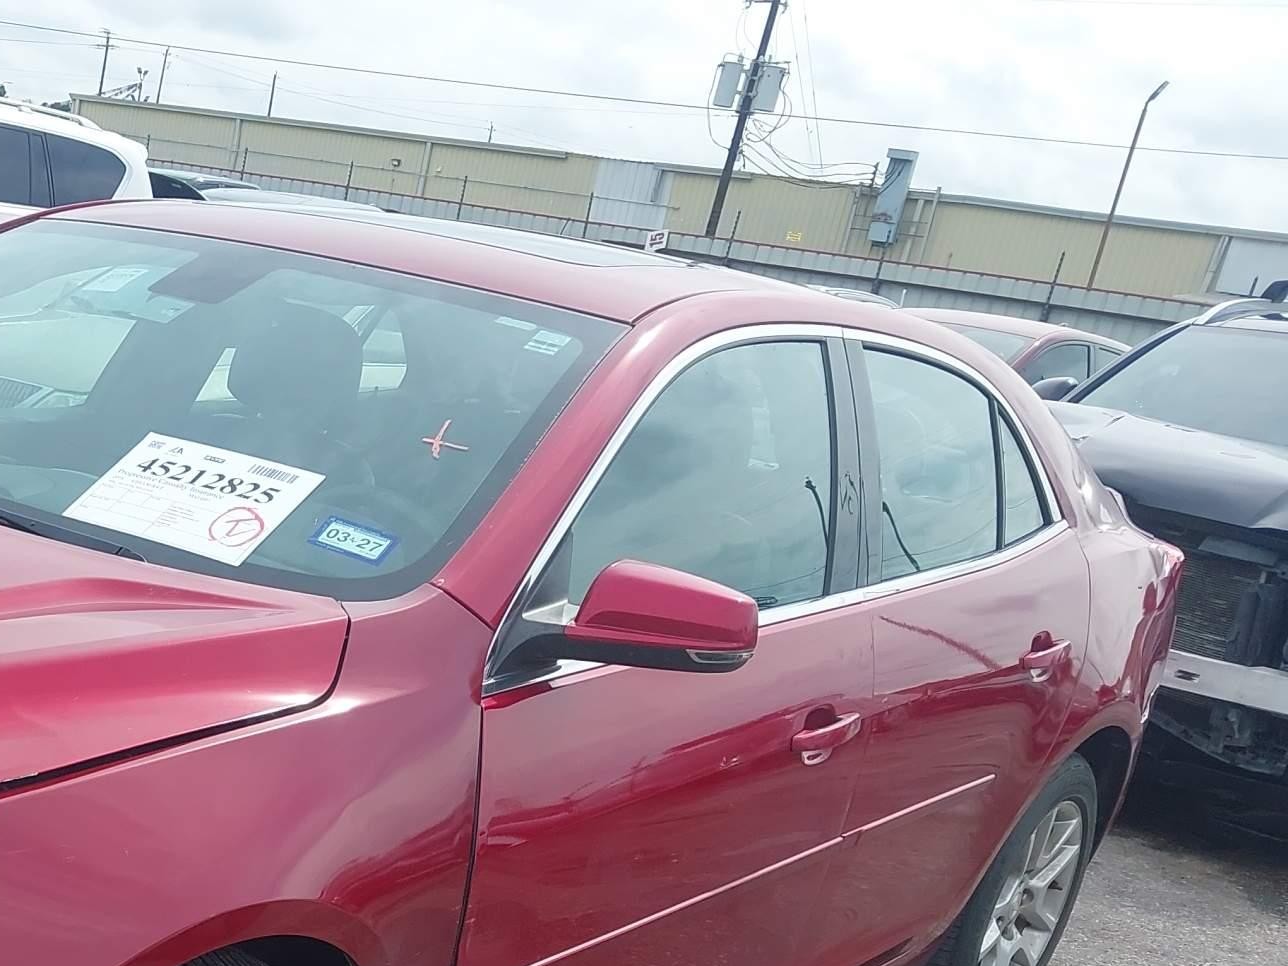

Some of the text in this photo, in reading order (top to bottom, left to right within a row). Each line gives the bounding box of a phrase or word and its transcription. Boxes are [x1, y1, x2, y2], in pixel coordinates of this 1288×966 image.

[648, 232, 664, 248] 15
[137, 457, 281, 504] 45212825
[325, 528, 351, 543] 03
[355, 538, 384, 553] 27
